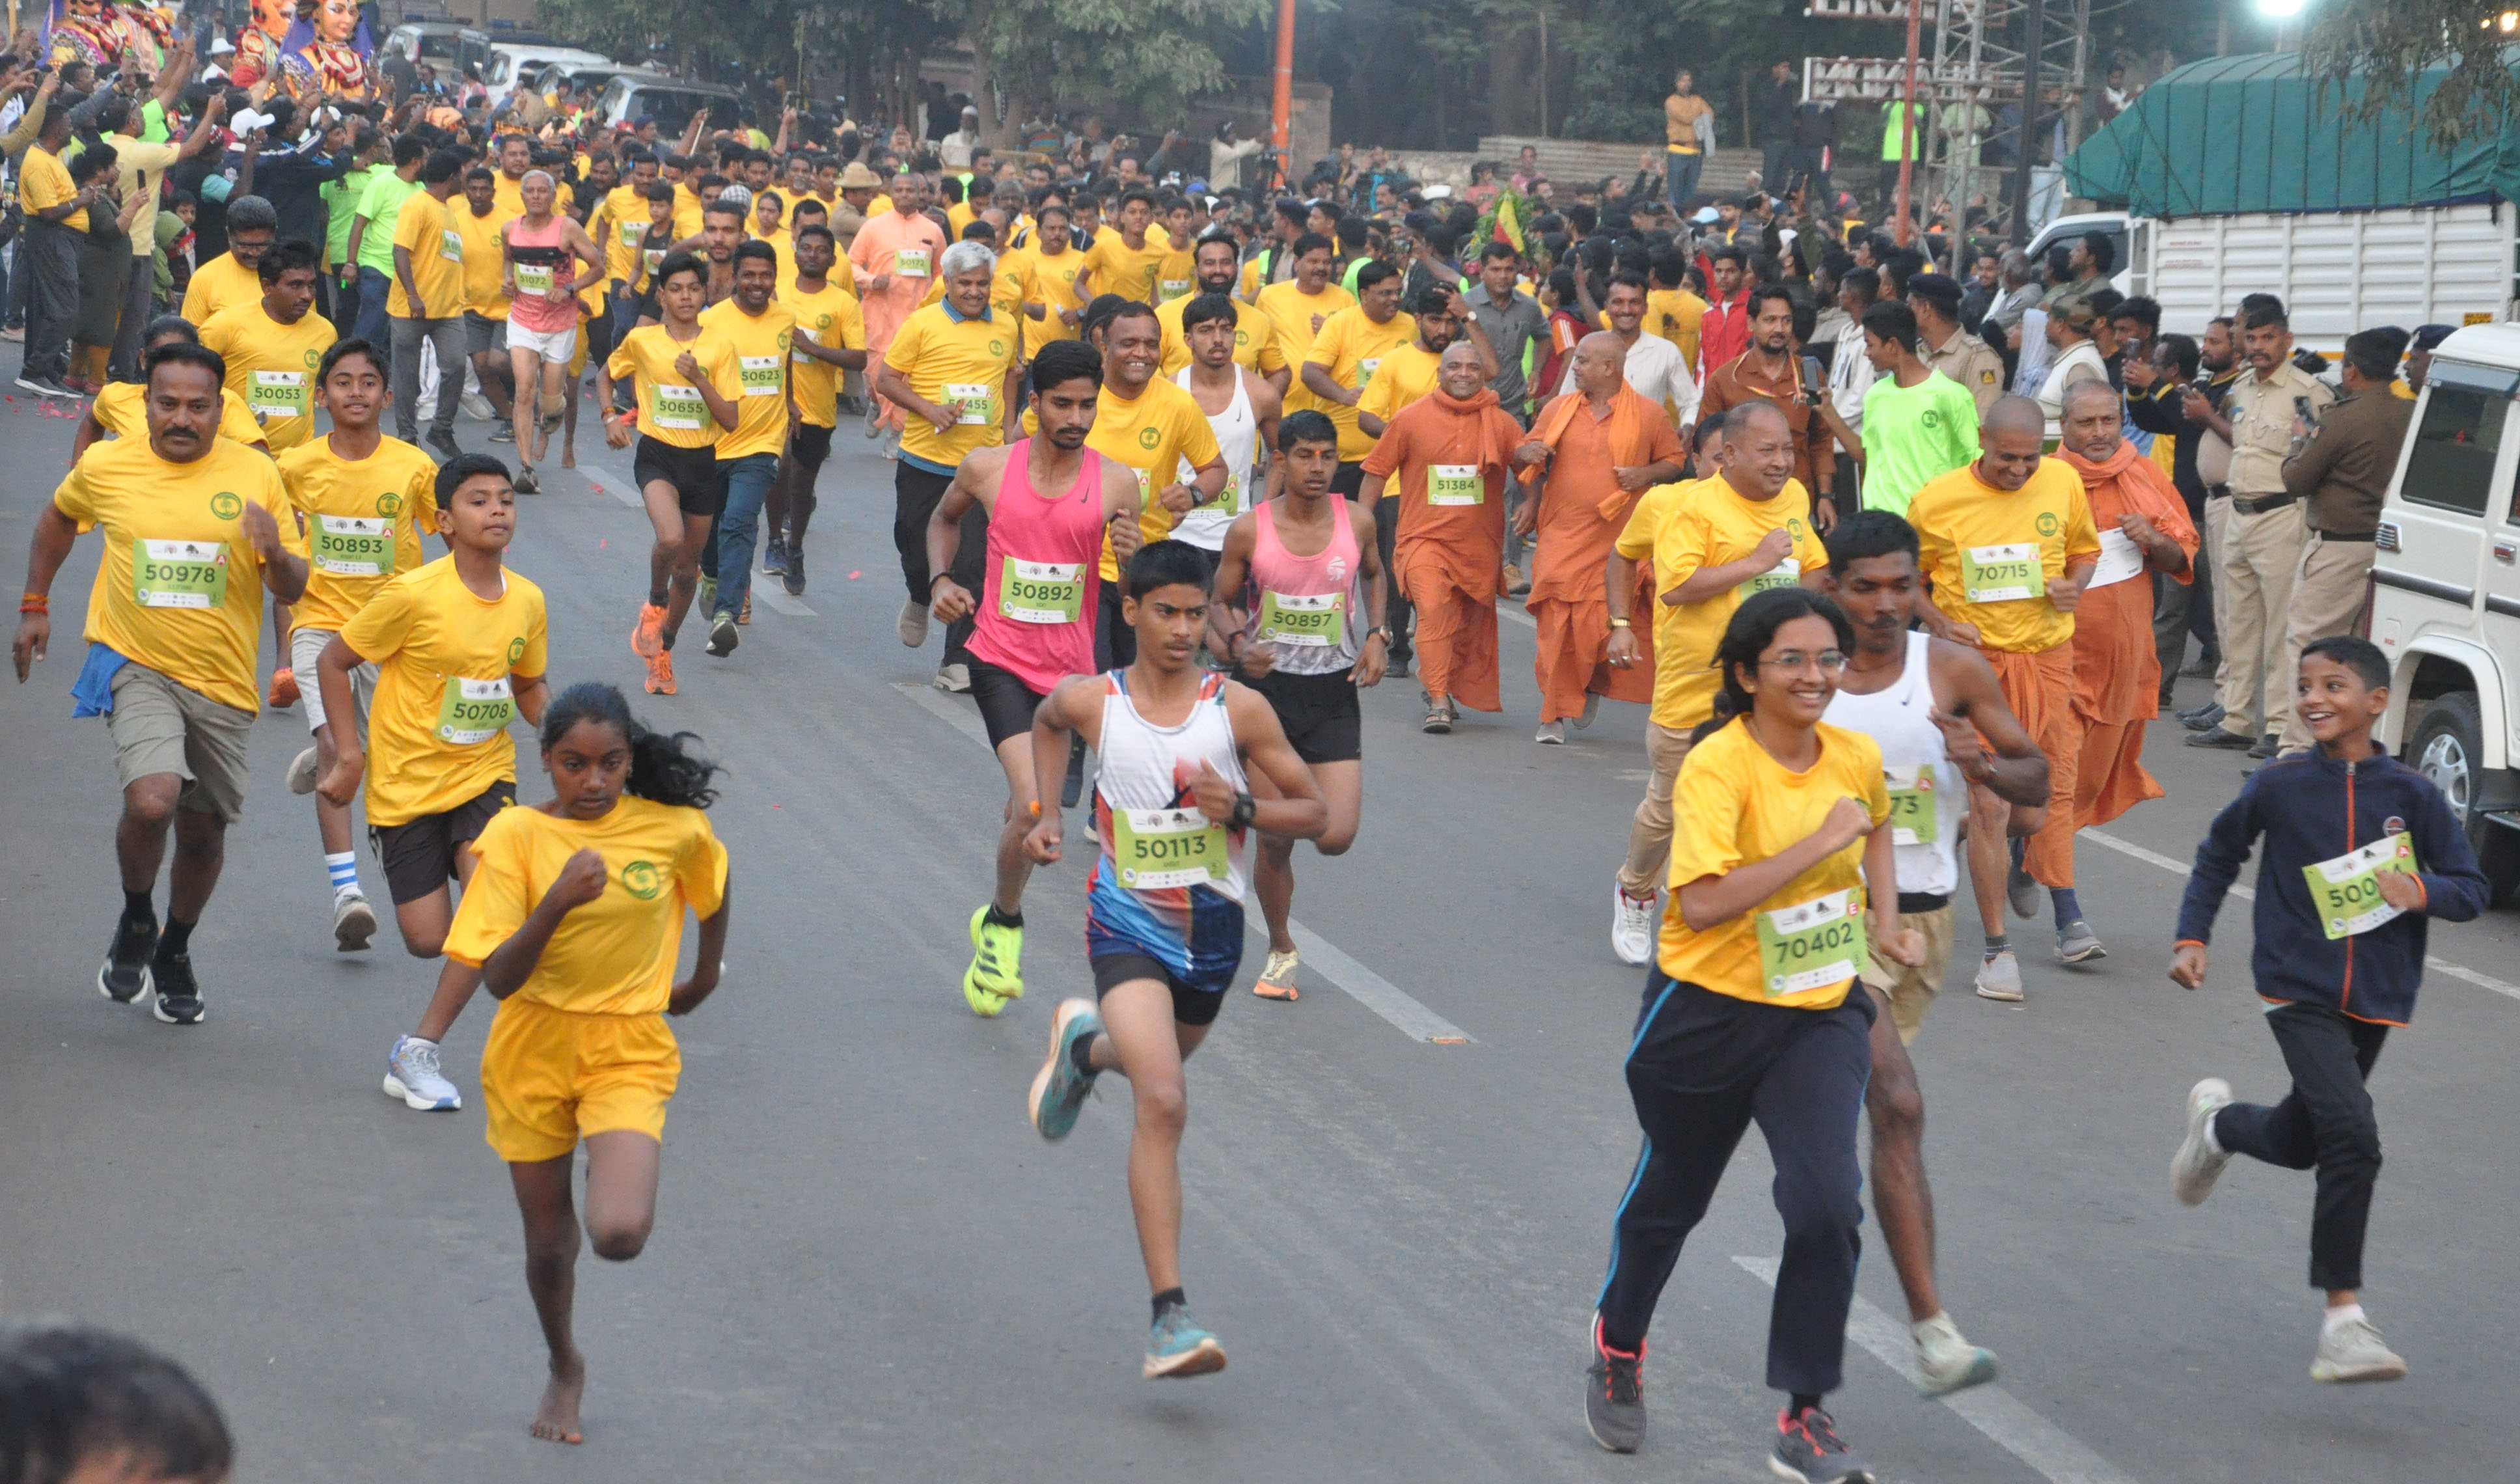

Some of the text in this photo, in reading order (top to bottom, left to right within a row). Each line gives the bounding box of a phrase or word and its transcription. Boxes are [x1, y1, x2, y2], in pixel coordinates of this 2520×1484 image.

[520, 274, 547, 285] 51072
[741, 370, 780, 381] 50623
[254, 387, 301, 400] 50053
[659, 400, 704, 414] 50655
[948, 398, 988, 409] 5455
[1438, 480, 1475, 490] 51384
[321, 535, 383, 553] 50893
[145, 564, 215, 583] 50978
[1975, 564, 2029, 581] 70715
[1011, 581, 1073, 601] 50892
[1273, 611, 1333, 627] 50897
[453, 702, 509, 720] 50708
[1890, 795, 1919, 816] 73
[1134, 834, 1207, 859] 50113
[1774, 922, 1854, 963] 70402
